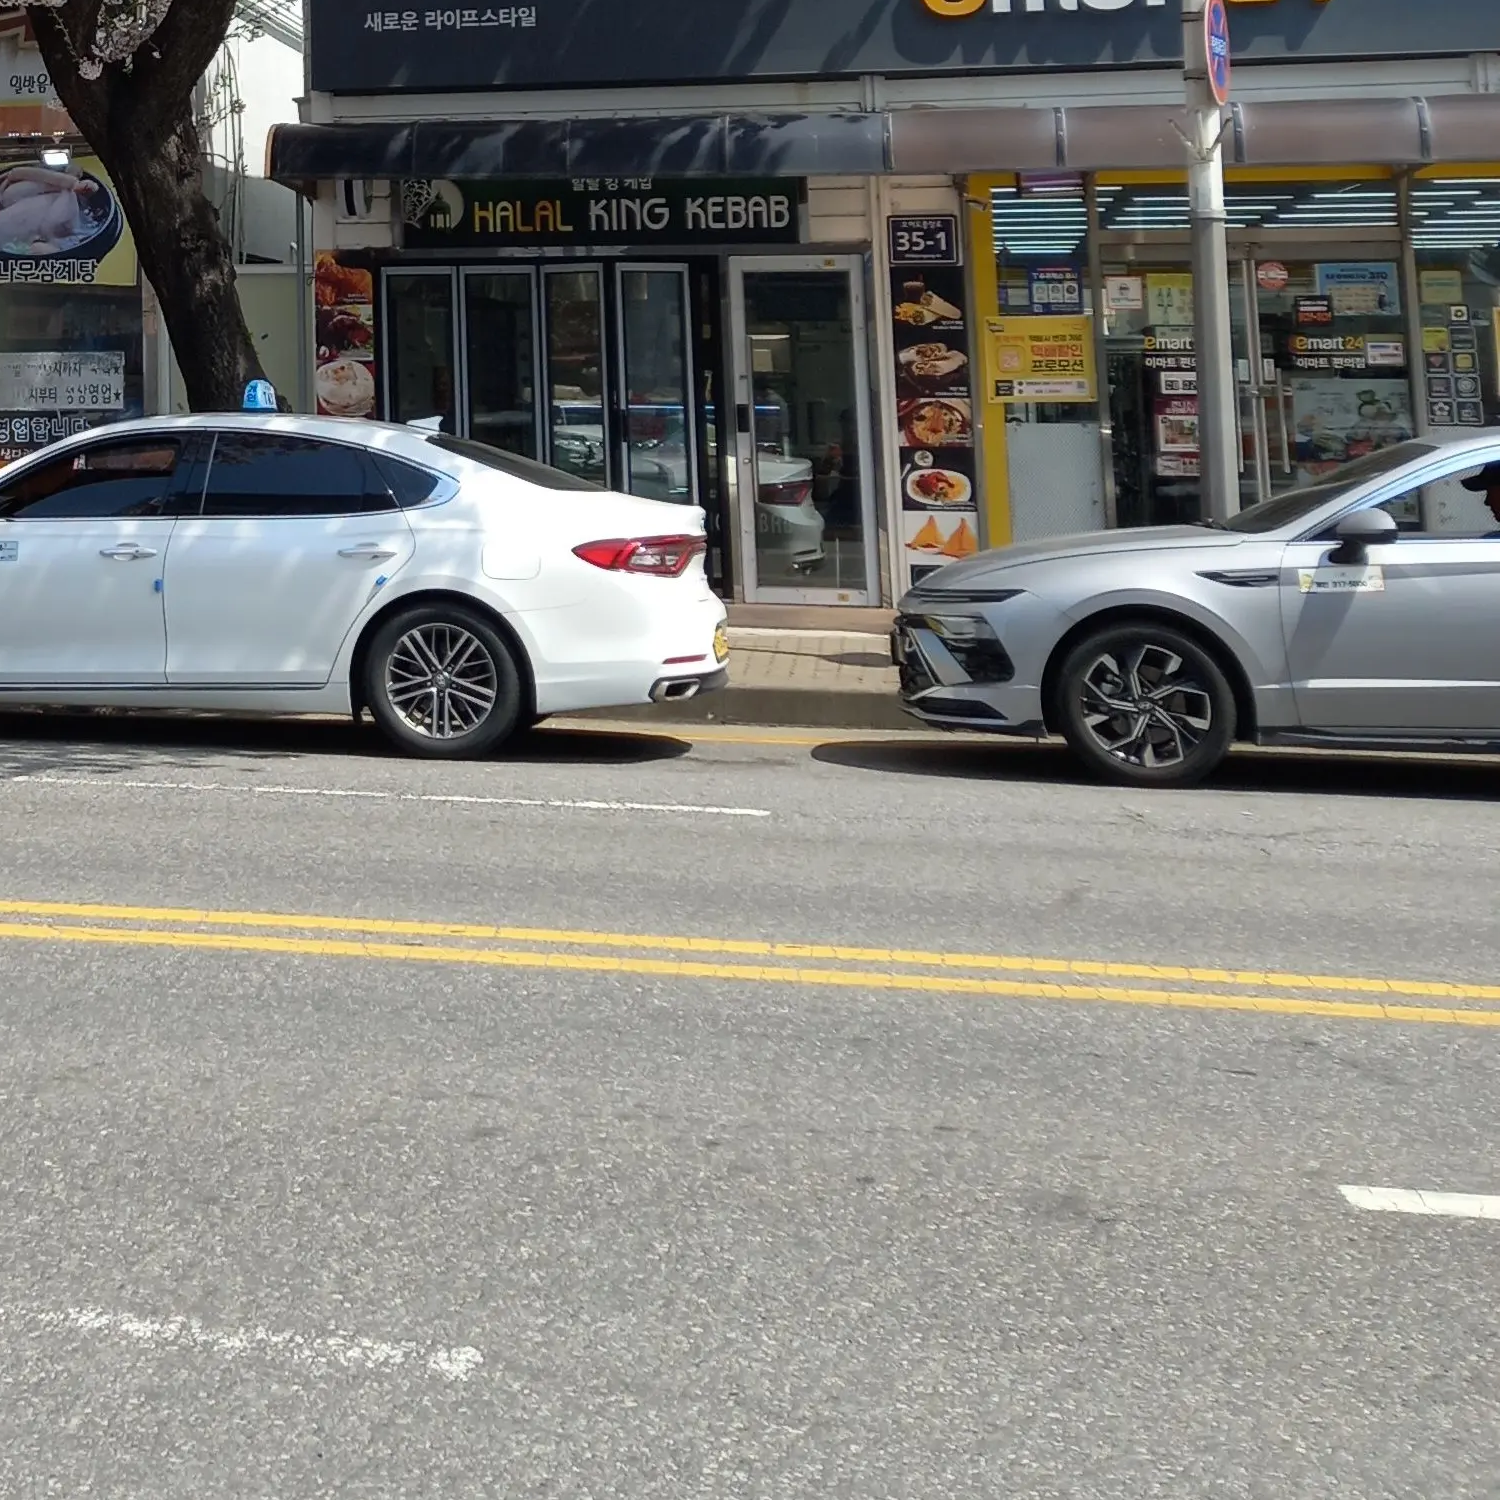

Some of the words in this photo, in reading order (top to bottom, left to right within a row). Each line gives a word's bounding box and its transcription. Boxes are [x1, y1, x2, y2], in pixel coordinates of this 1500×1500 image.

[364, 11, 418, 32] 새로운
[425, 6, 537, 31] 라이프스타일
[9, 73, 53, 94] 일반음
[474, 202, 573, 232] HALAL
[588, 198, 670, 230] KING
[685, 195, 791, 229] KEBAB
[896, 231, 947, 251] 35-1
[1031, 359, 1085, 373] 프로모션
[1145, 356, 1179, 369] 이마트
[1296, 356, 1330, 369] 이마트
[1332, 356, 1366, 369] 편의점
